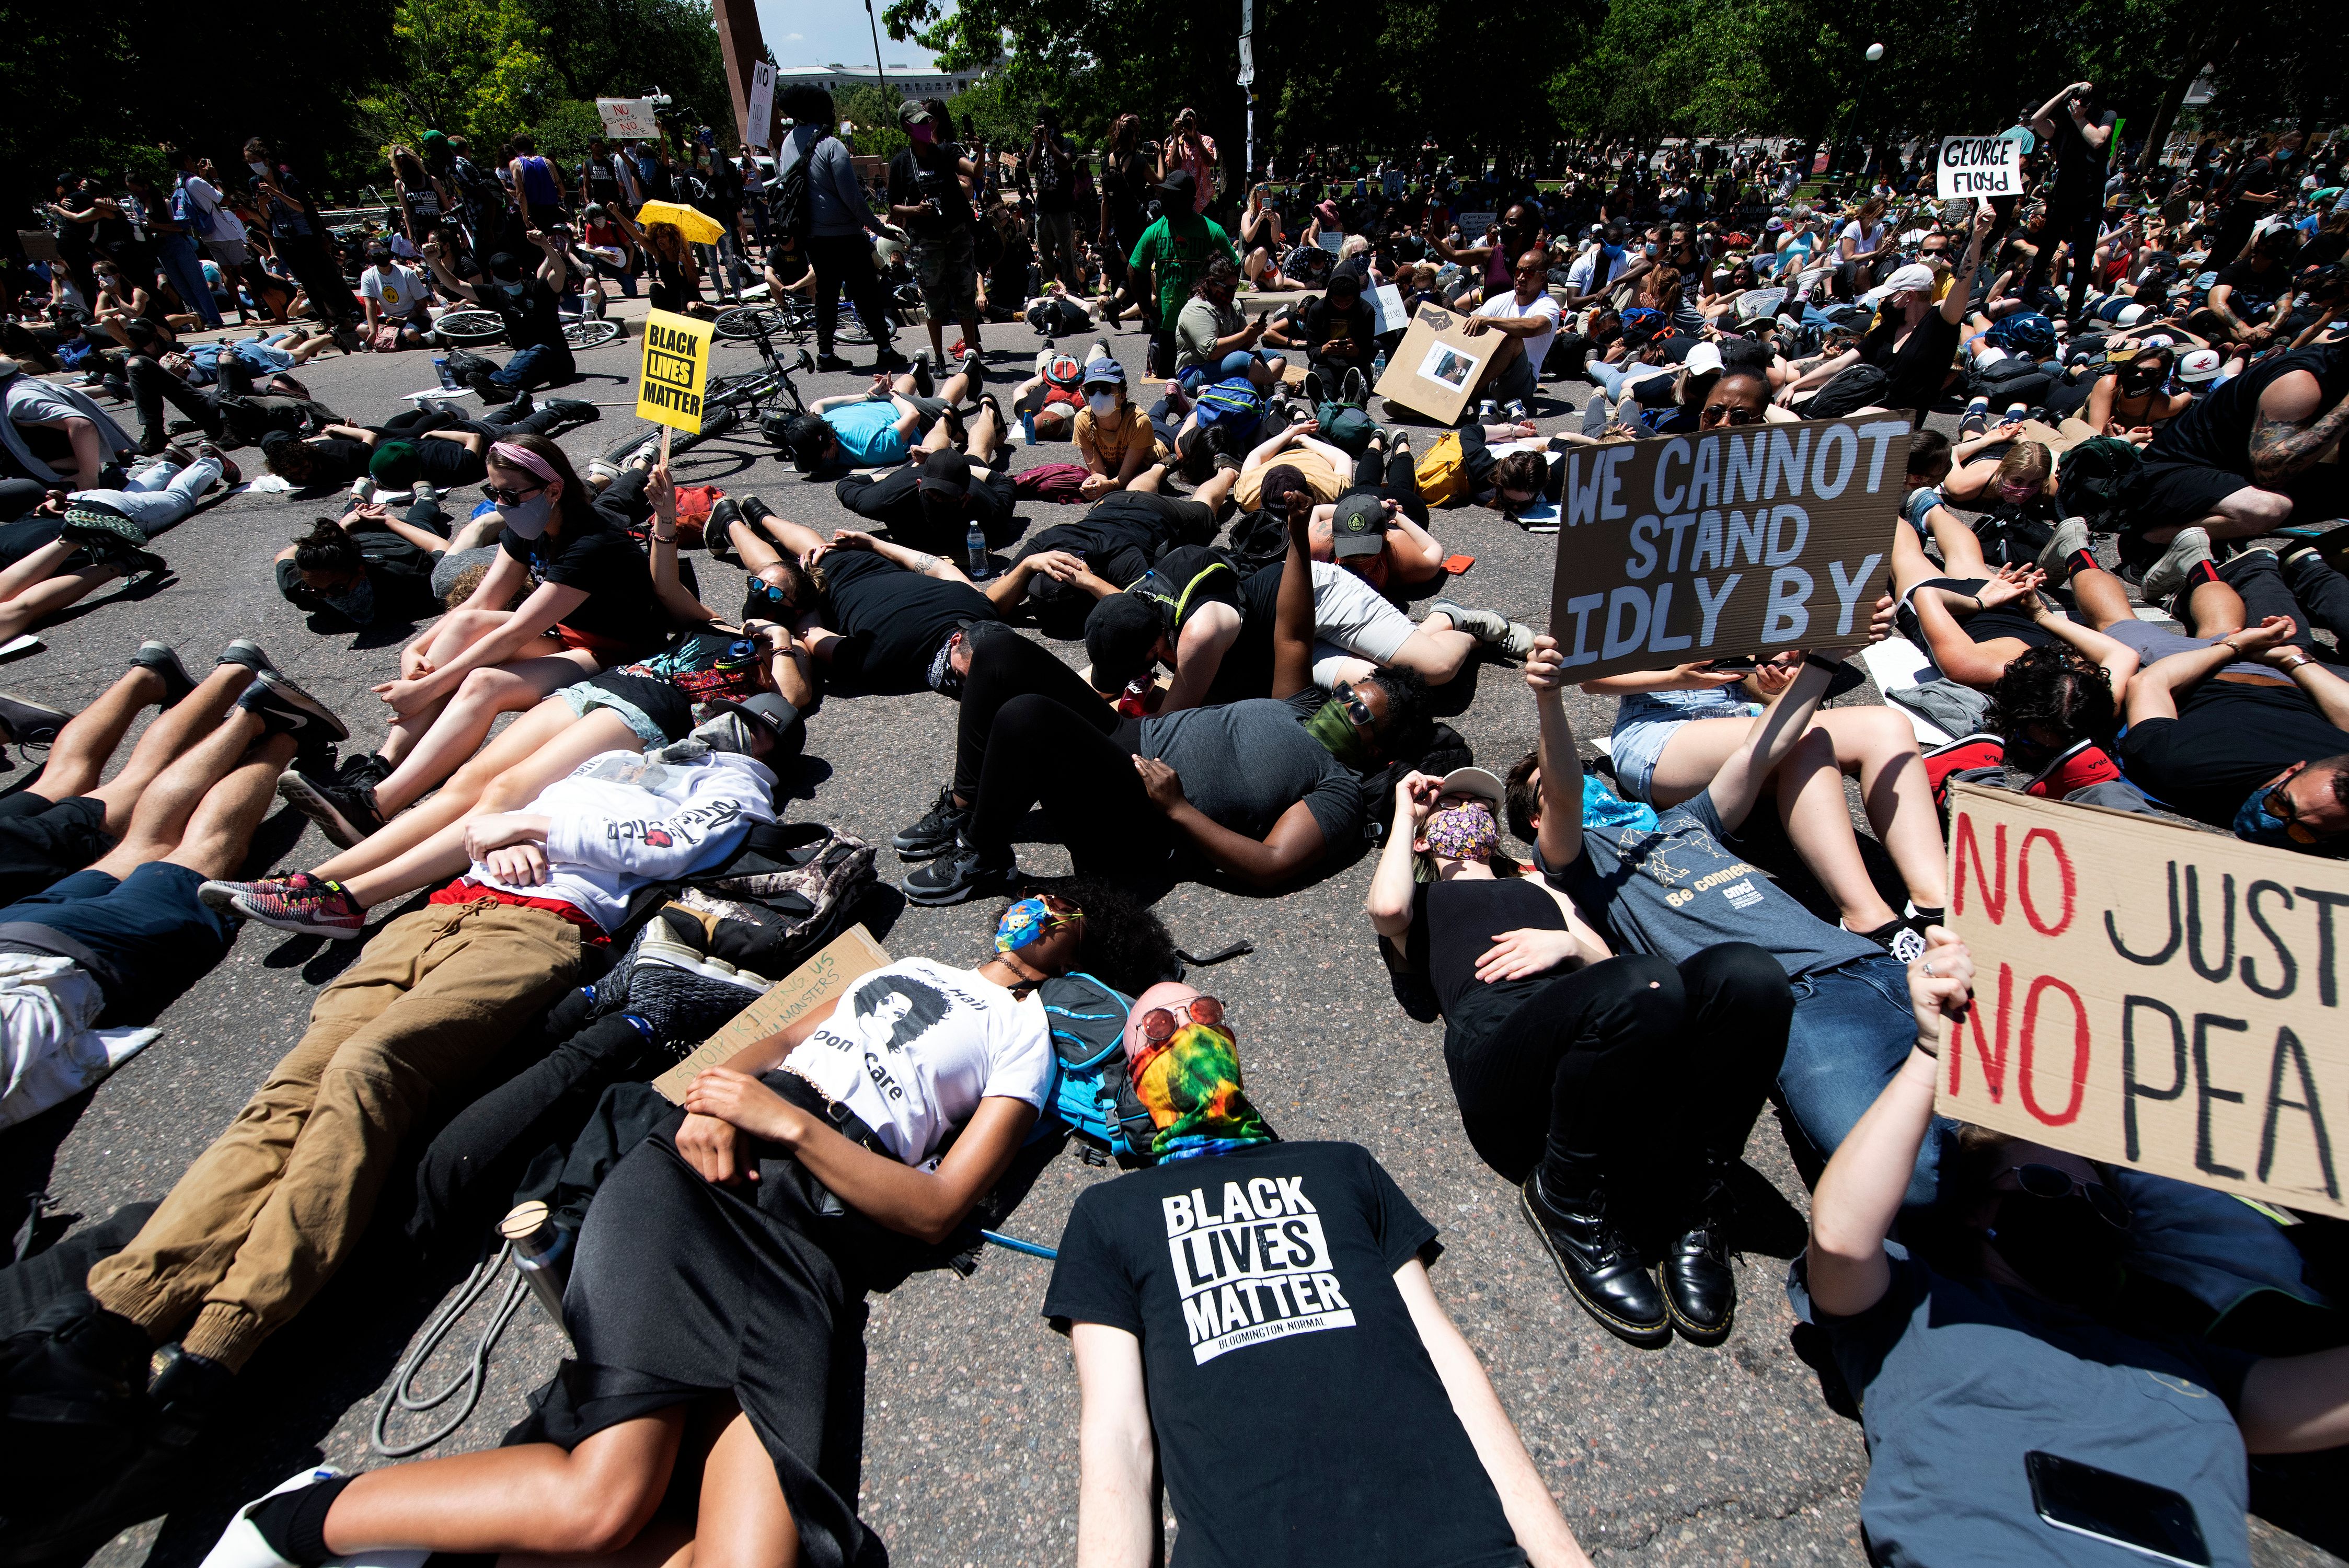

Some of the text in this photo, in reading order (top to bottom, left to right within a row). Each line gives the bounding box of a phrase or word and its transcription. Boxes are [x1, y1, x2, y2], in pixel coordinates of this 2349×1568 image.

[756, 66, 769, 87] NO
[613, 103, 628, 116] NO
[753, 104, 762, 121] NO
[755, 86, 773, 105] JUSTE
[620, 121, 637, 131] NO
[621, 128, 649, 137] PEACE
[1944, 139, 2013, 167] GEORGE
[1740, 205, 1771, 214] SOLIDARITY
[649, 324, 699, 358] BLACK
[649, 353, 690, 385] LIVES
[643, 381, 701, 417] MATTER
[1569, 420, 1911, 526] WE CANNOT
[1626, 504, 1810, 579] STAND
[1561, 553, 1883, 669] IDLY BY
[2088, 758, 2108, 769] FILA
[1954, 811, 2077, 937] NO
[1665, 889, 1695, 907] Be
[675, 1036, 723, 1080] STOP
[808, 952, 835, 975] US
[865, 1052, 903, 1101] Care
[1949, 962, 2349, 1201] NO PEA
[1162, 1175, 1317, 1238] BLACK
[1182, 1220, 1316, 1288] LIVES
[1182, 1272, 1350, 1346] MATTER
